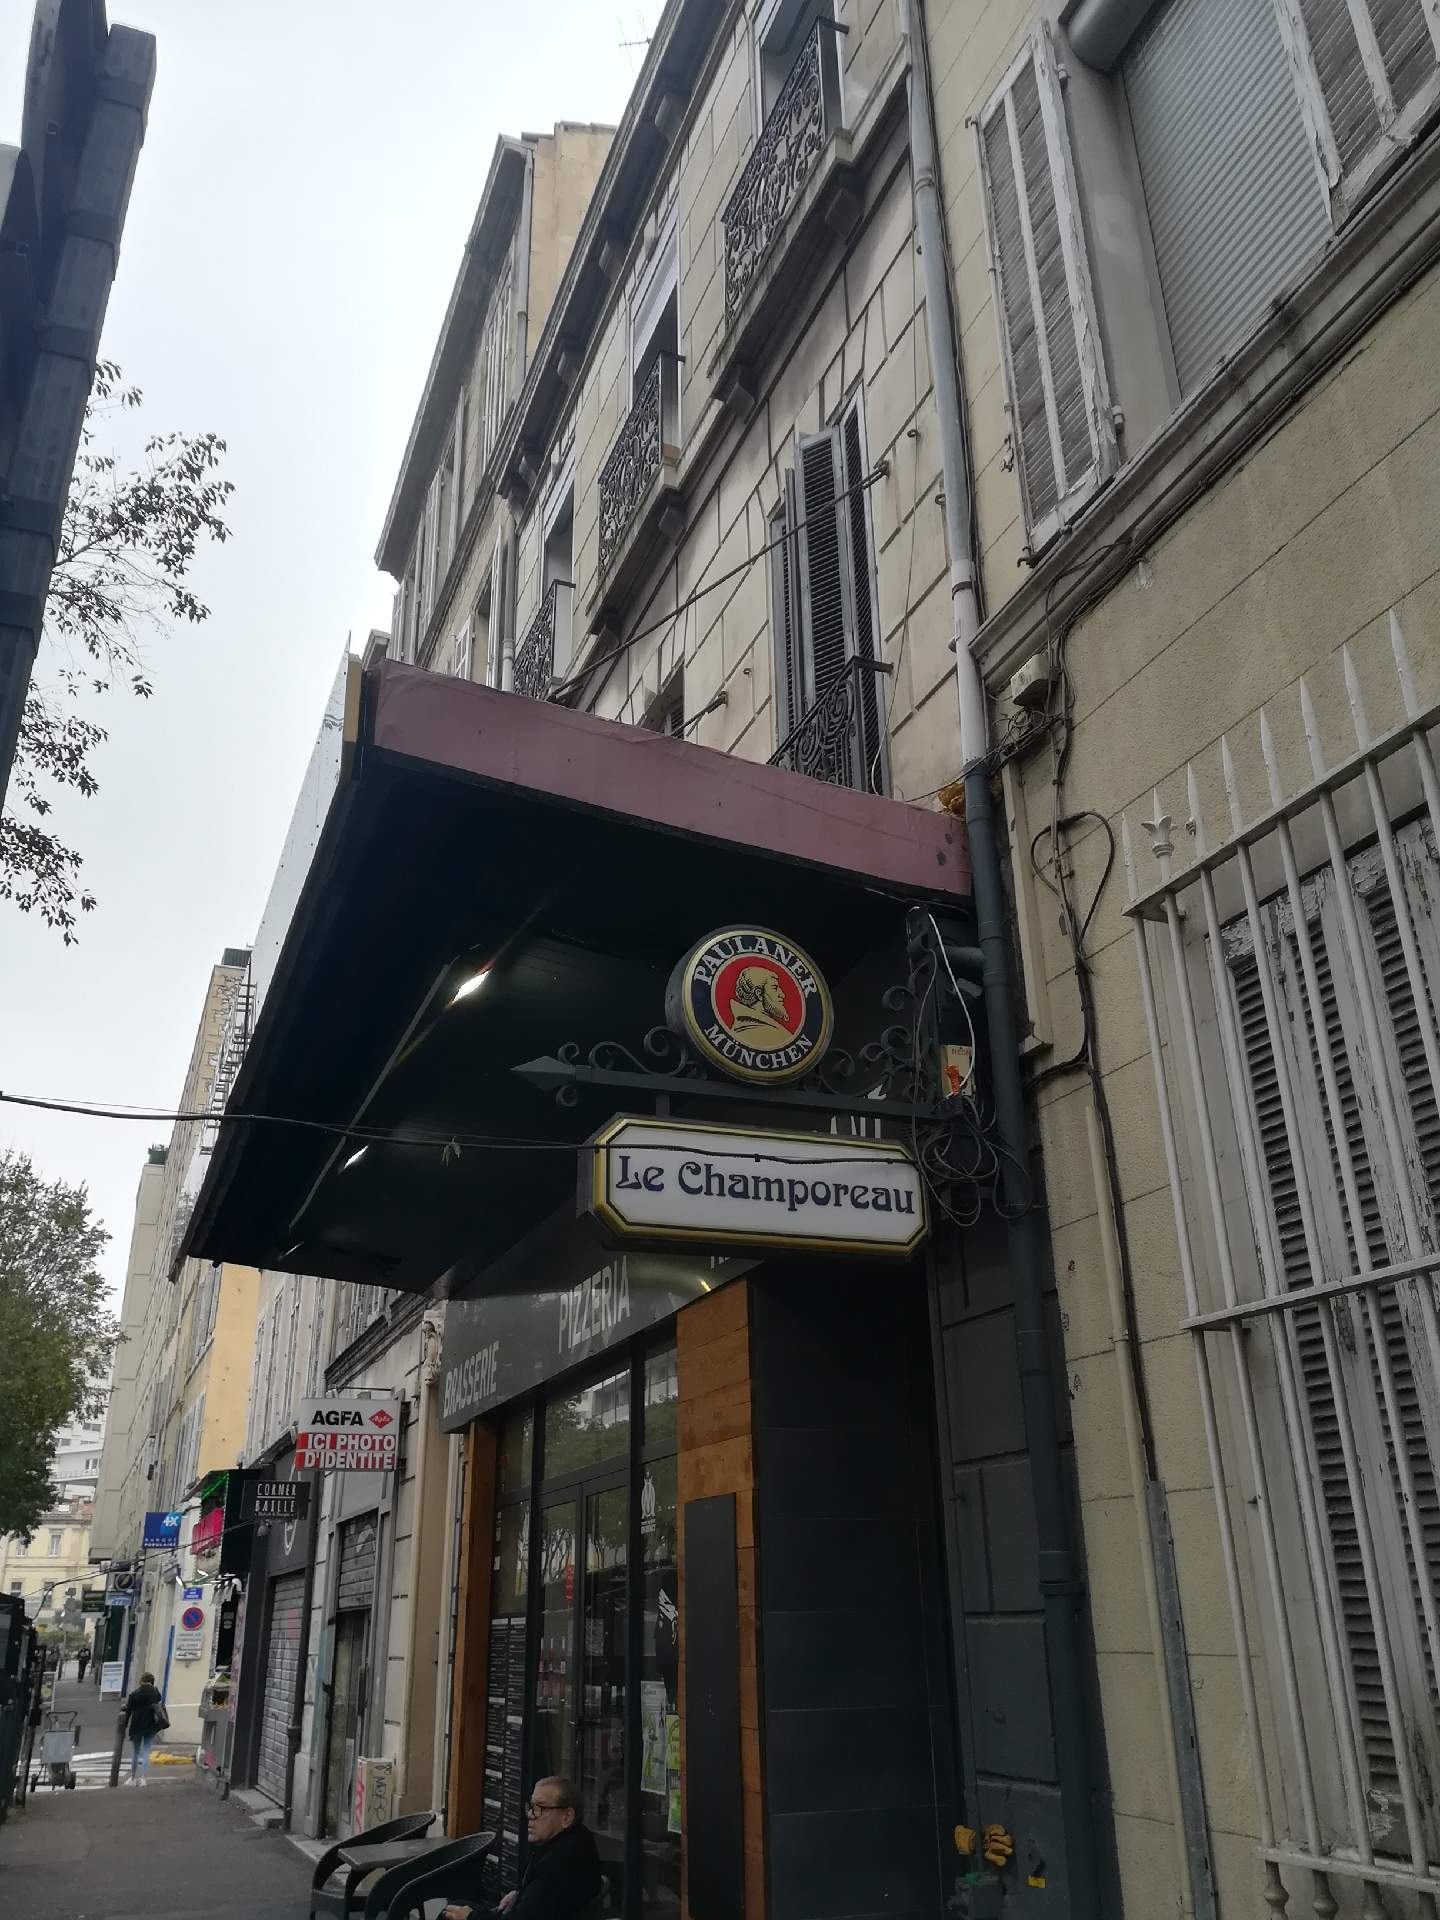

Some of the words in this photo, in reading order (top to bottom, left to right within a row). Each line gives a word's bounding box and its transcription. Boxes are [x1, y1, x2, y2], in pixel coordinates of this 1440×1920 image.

[693, 934, 818, 998] PAULANER
[703, 1022, 815, 1072] MÜNCHEN
[615, 1155, 665, 1193] Le
[678, 1161, 915, 1214] Champoreau
[558, 1255, 630, 1353] PIZZERIA
[443, 1340, 499, 1418] BRASSERIE
[311, 1410, 364, 1426] AGFA
[307, 1433, 331, 1450] ICI
[336, 1434, 396, 1451] PHOTO
[304, 1451, 394, 1469] D'IDENTITE
[255, 1499, 296, 1513] BAILLE
[256, 1483, 297, 1496] CORNER
